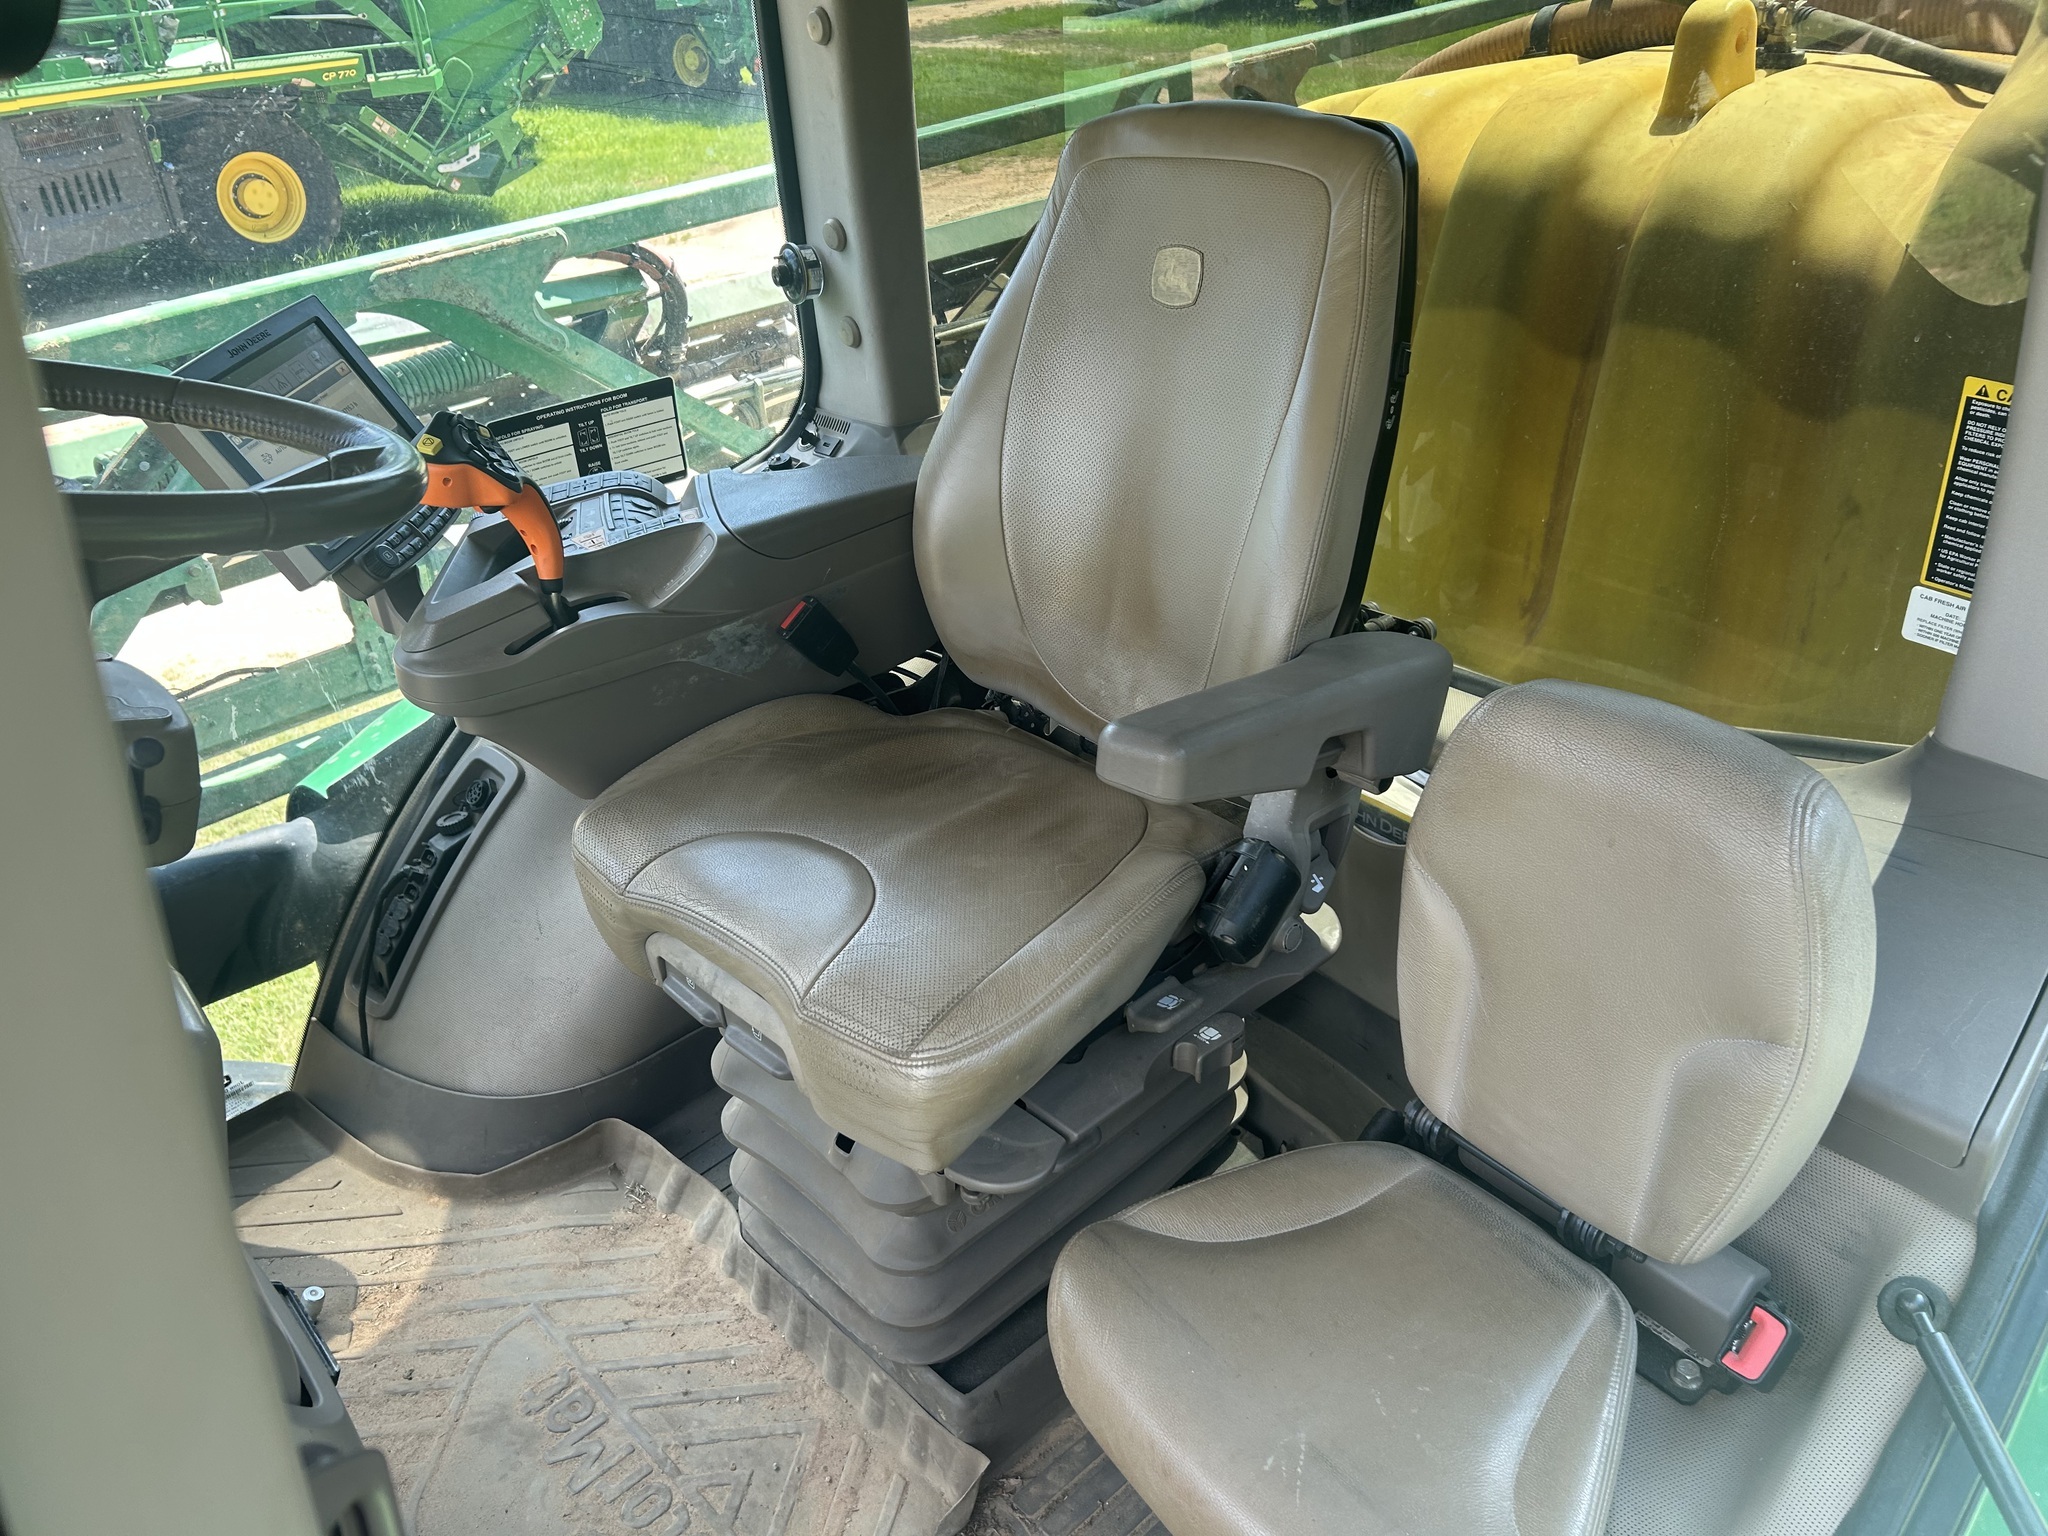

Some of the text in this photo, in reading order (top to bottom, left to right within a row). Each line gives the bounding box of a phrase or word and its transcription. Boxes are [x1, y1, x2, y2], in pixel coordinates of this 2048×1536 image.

[322, 69, 357, 81] CP 770
[227, 329, 272, 359] JOHN DEERE
[536, 392, 628, 421] OPERATING INSTRUCTIONS FOR BOOM
[600, 405, 613, 413] FOLD
[612, 402, 622, 410] FOR
[1965, 430, 1986, 438] FILTERS
[1966, 425, 1994, 435] PRESSURE
[495, 432, 511, 441] NFOLD
[1964, 435, 1990, 445] CHEMICAL
[579, 446, 589, 454] TILT
[589, 443, 603, 452] DOWN
[588, 460, 601, 468] RAISE
[1920, 593, 1933, 601] CAB
[1934, 597, 1955, 607] FRESH
